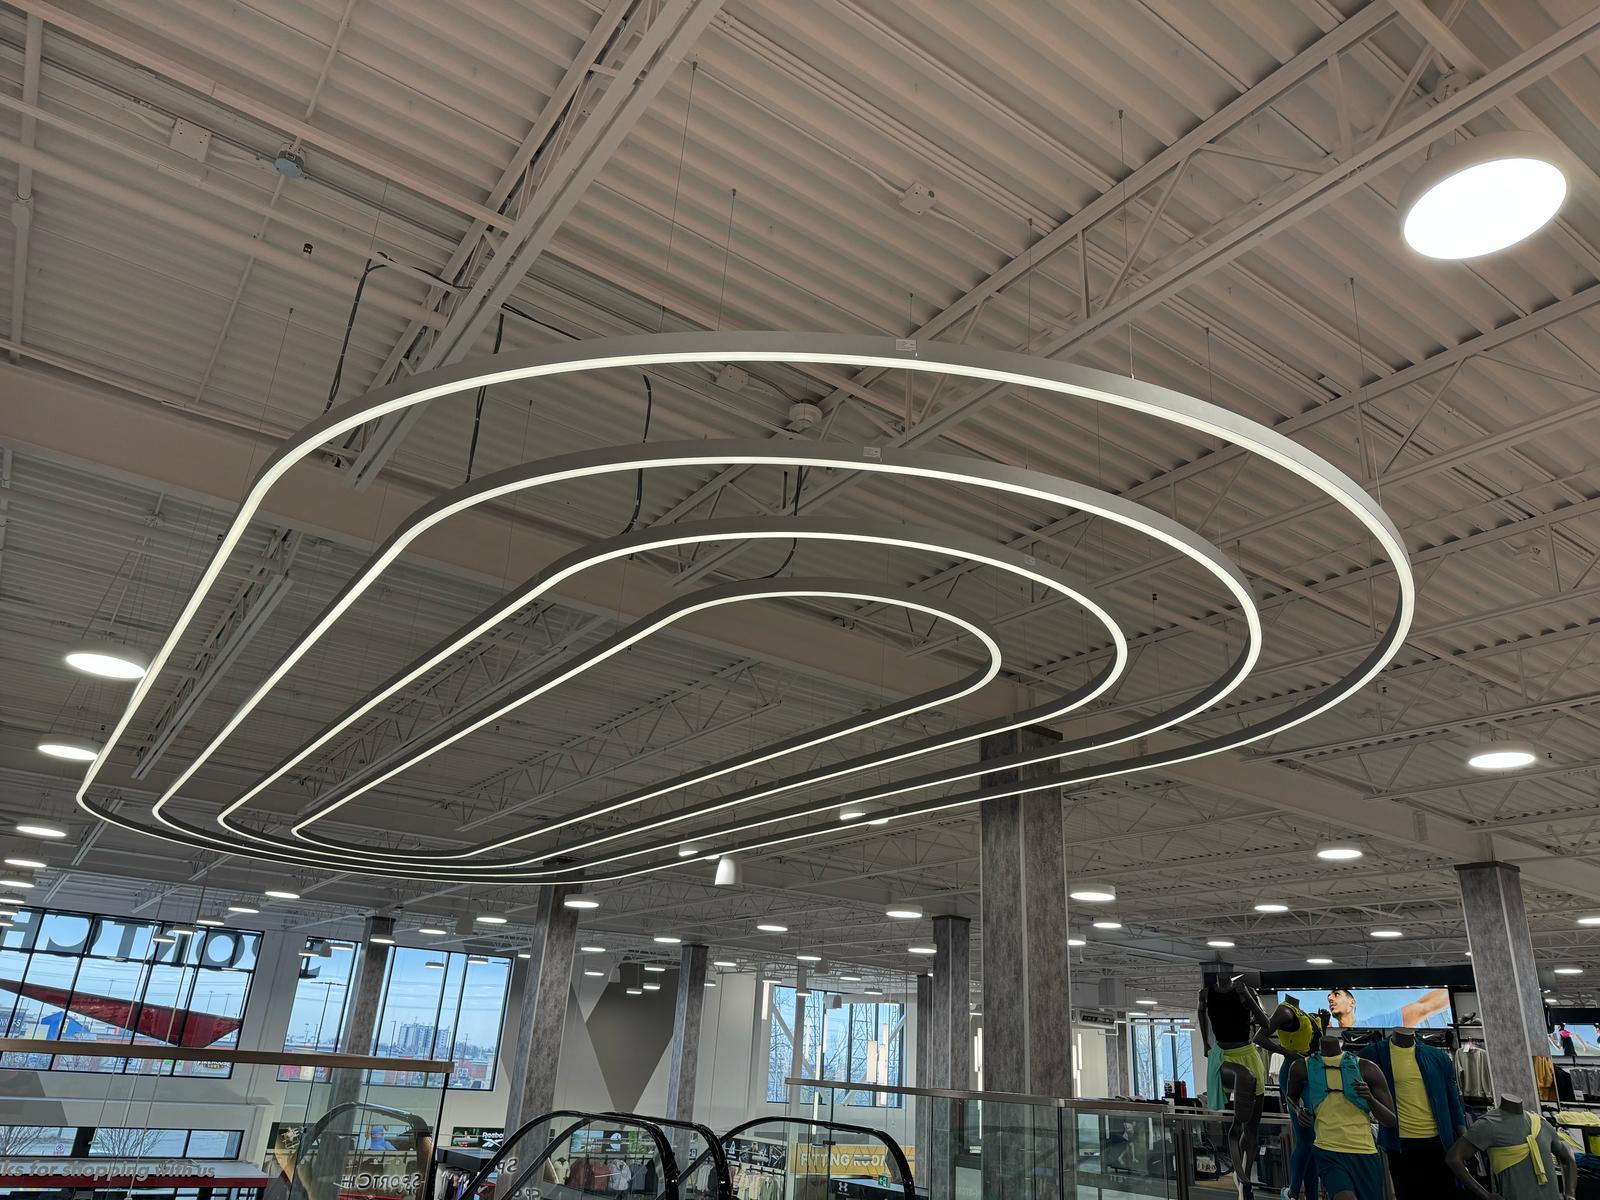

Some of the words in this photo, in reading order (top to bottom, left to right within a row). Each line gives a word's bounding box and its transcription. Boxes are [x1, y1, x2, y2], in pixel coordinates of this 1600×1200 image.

[853, 1153, 887, 1166] ROO
[0, 1160, 24, 1177] ks
[28, 1160, 58, 1177] for
[62, 1160, 150, 1181] shopping
[155, 1162, 195, 1178] with
[199, 1165, 216, 1178] us
